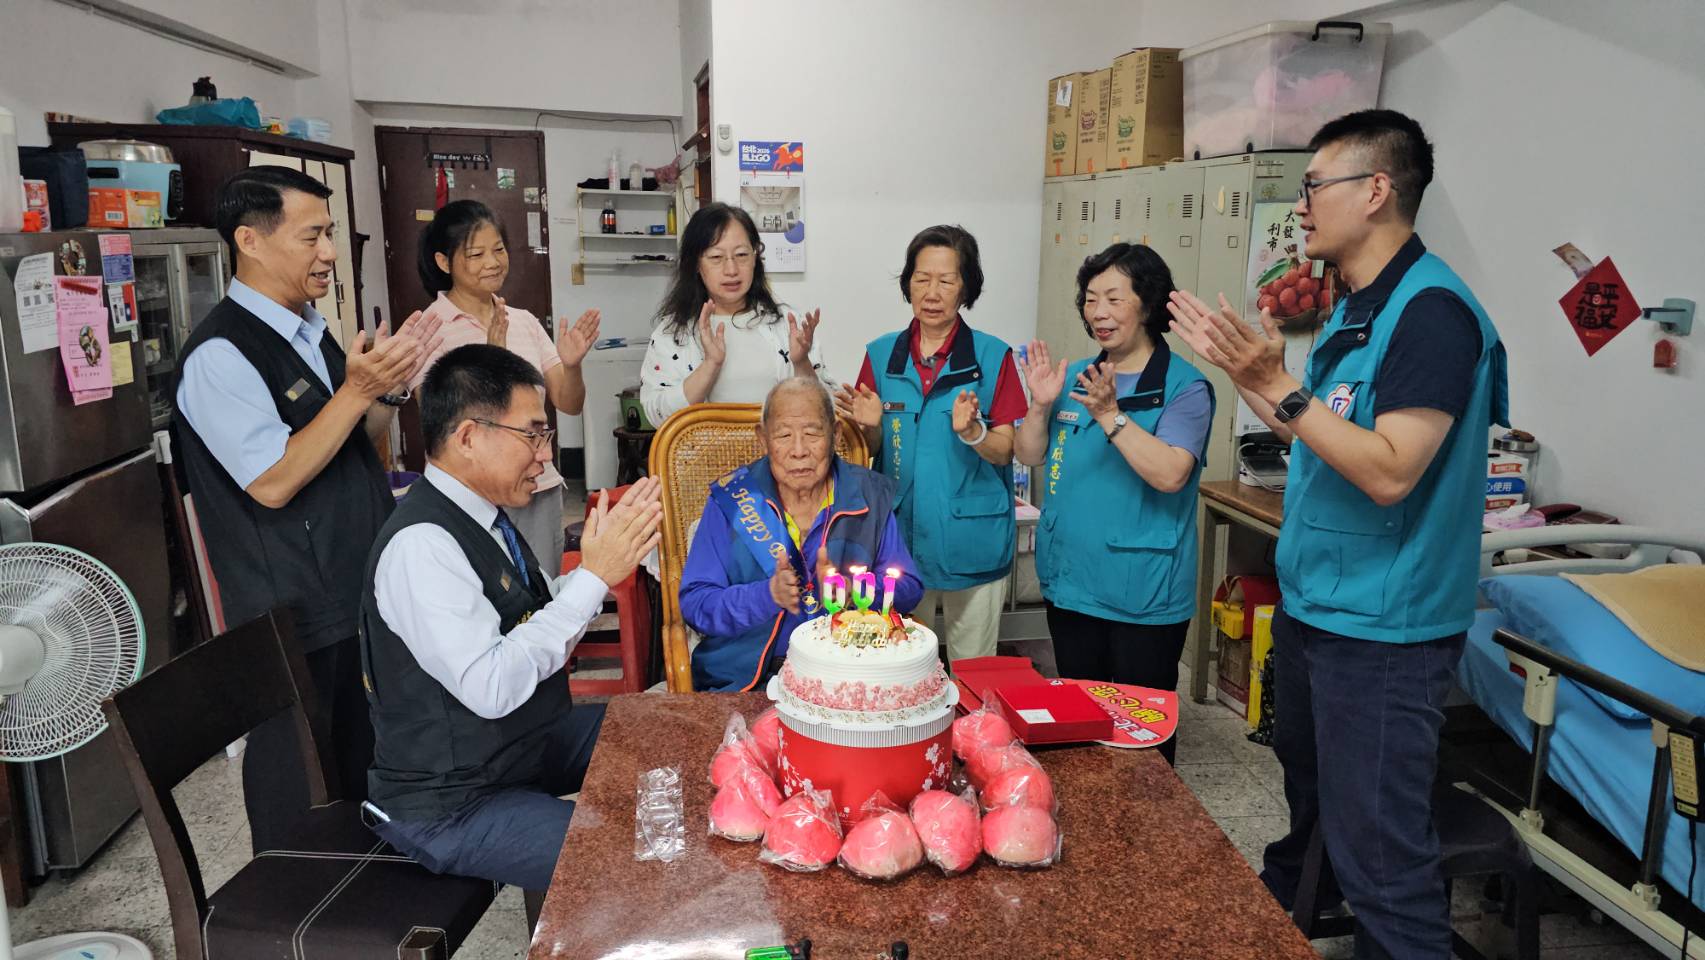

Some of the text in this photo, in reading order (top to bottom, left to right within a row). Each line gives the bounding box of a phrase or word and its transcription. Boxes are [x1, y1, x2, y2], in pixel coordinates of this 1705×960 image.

[1267, 222, 1281, 252] 利市
[1283, 209, 1296, 239] 大發
[731, 487, 774, 542] Happy
